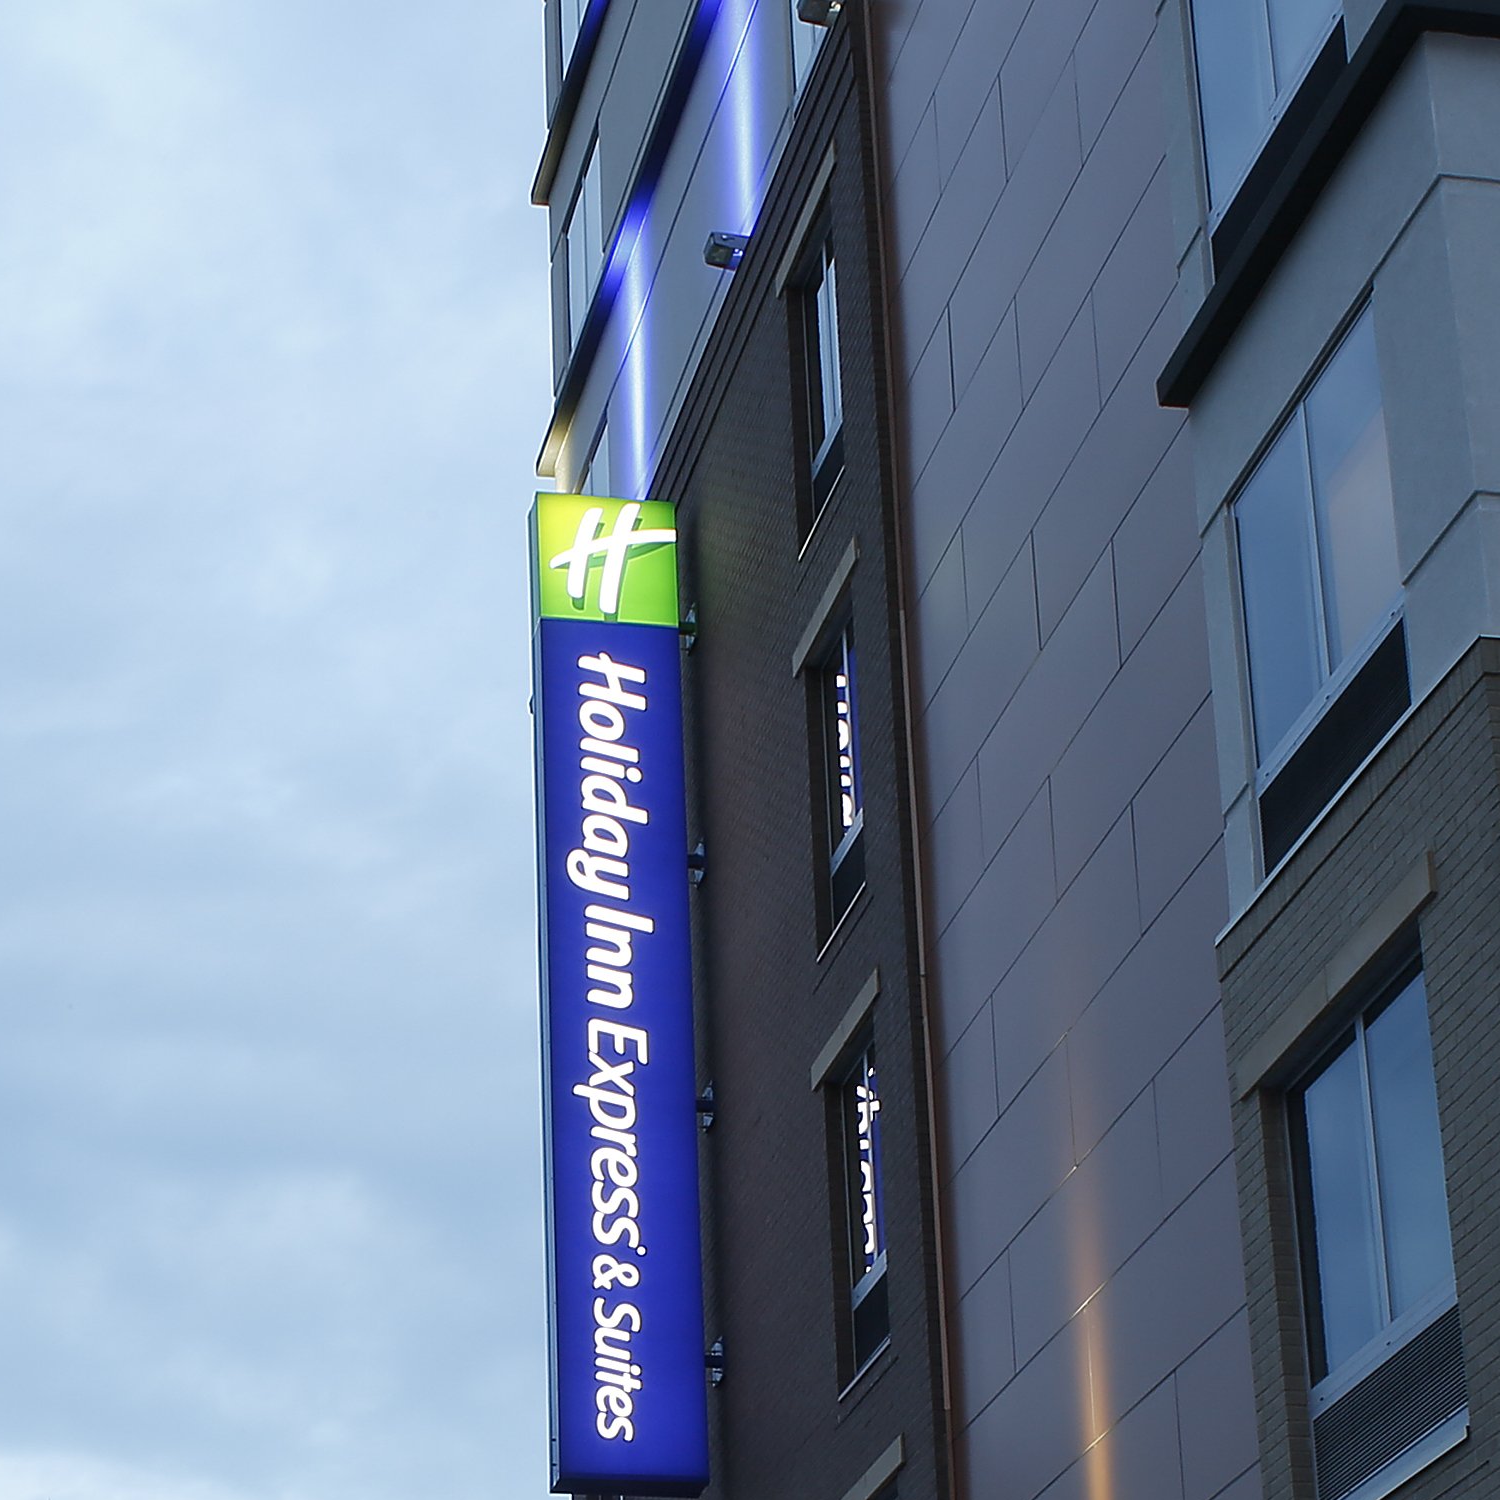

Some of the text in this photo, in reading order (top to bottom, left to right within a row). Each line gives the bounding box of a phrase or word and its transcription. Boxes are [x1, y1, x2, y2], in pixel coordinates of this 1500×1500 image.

[566, 651, 655, 1443] Holiday Inn Express & Suites
